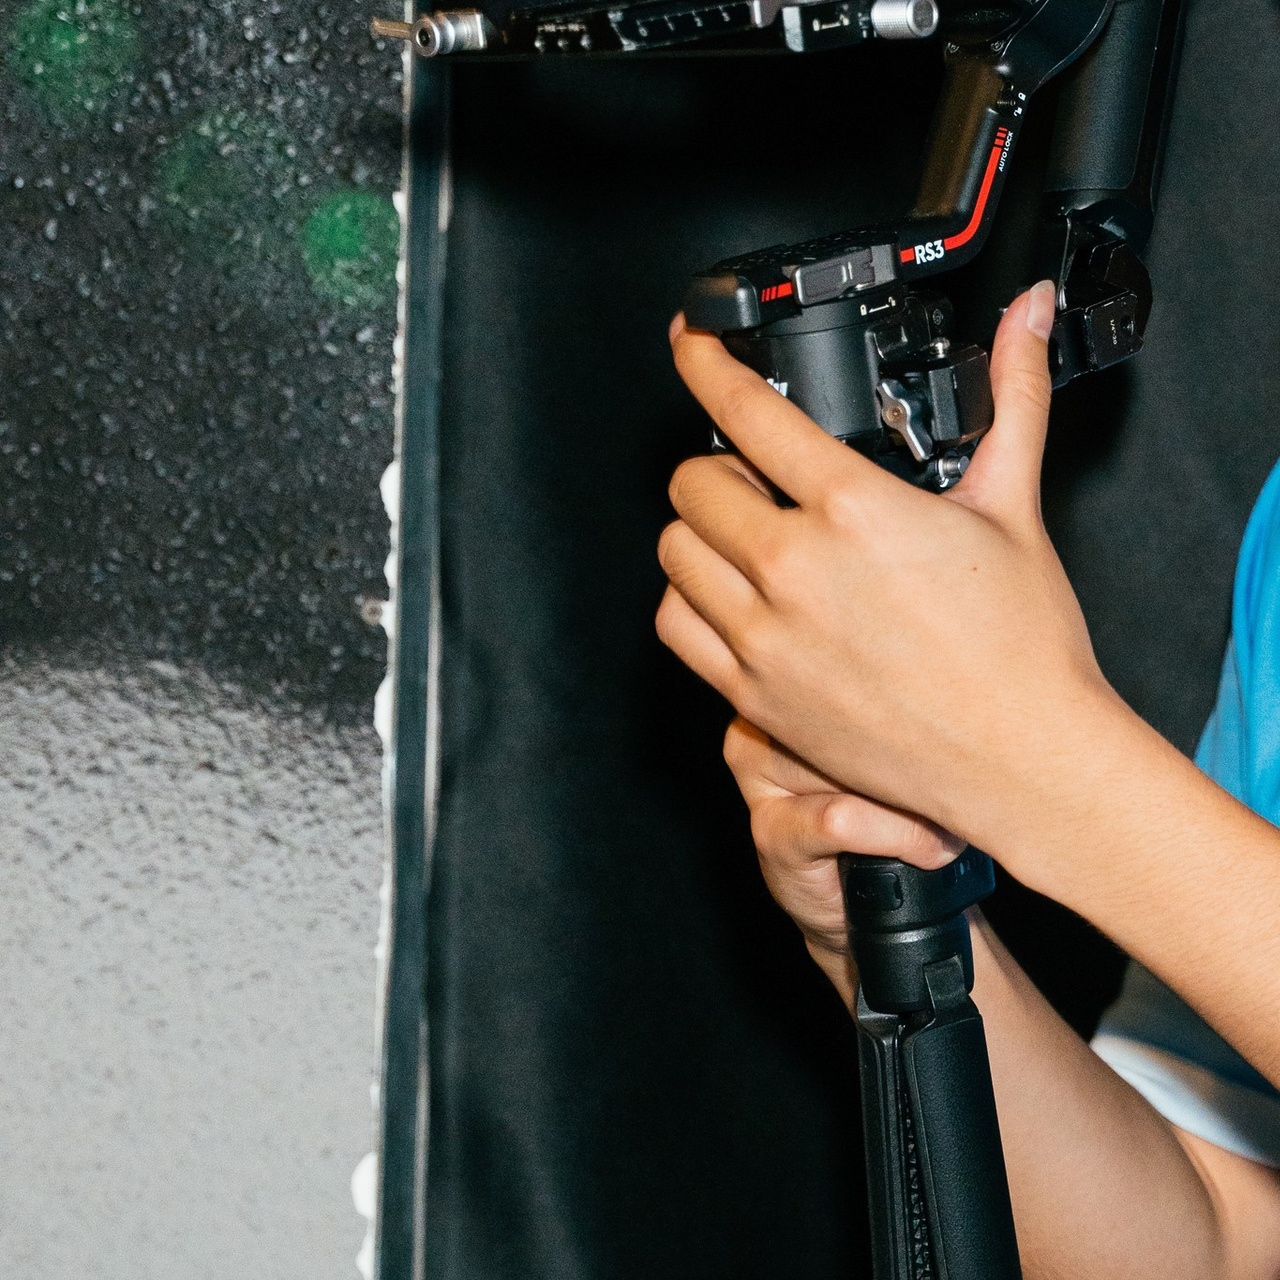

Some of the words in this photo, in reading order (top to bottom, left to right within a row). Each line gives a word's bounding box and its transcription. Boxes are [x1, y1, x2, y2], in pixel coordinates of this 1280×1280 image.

[998, 151, 1008, 173] AUTO
[1003, 131, 1014, 152] LOCK
[914, 238, 945, 265] RS3
